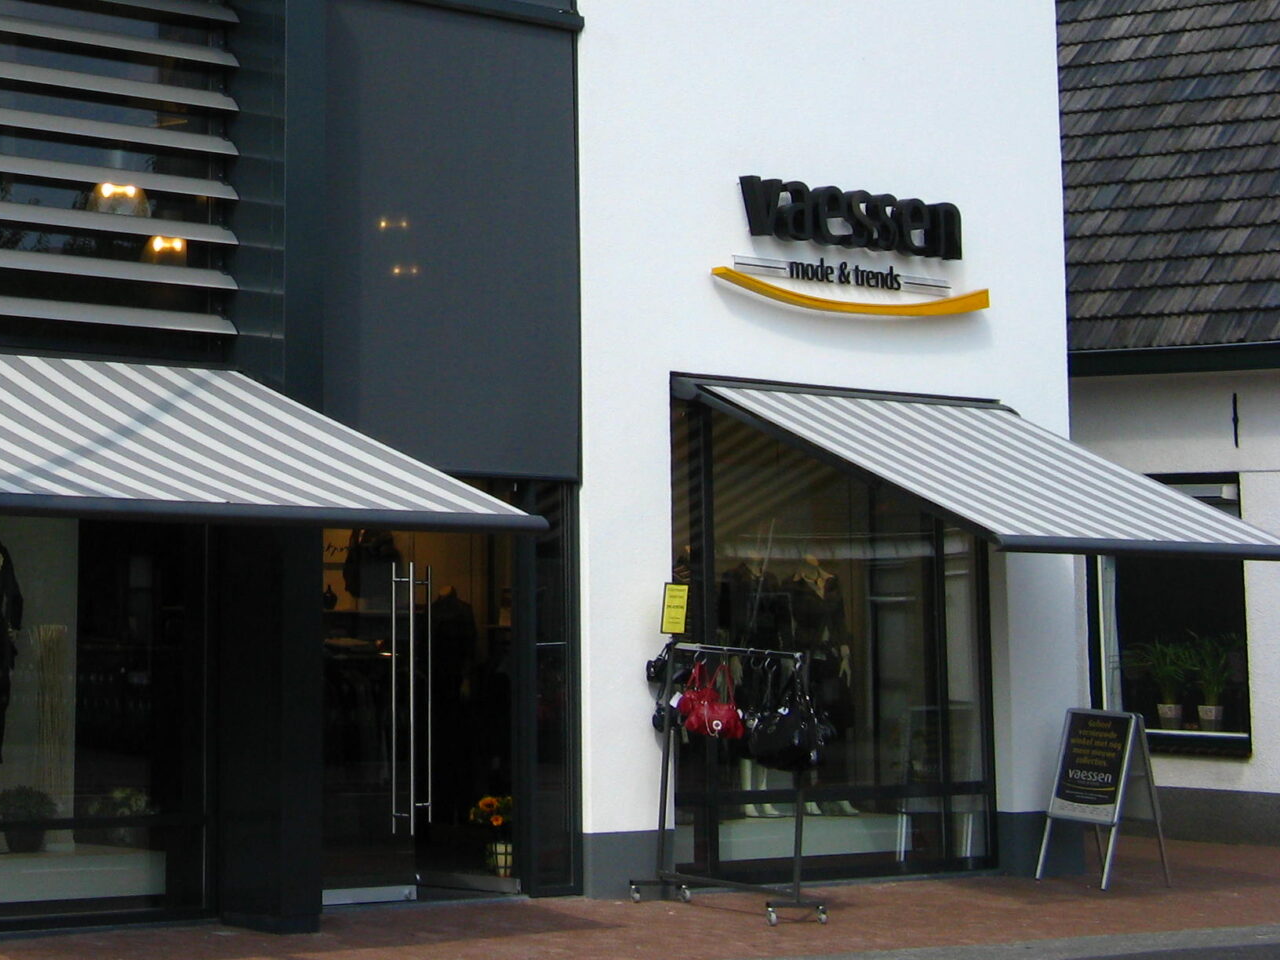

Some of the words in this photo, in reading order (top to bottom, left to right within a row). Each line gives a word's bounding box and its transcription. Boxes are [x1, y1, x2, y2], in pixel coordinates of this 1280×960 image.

[739, 175, 963, 261] vaessen
[789, 258, 834, 284] mode
[838, 263, 851, 285] &
[854, 265, 901, 291] trends
[1068, 768, 1113, 783] vaessen
